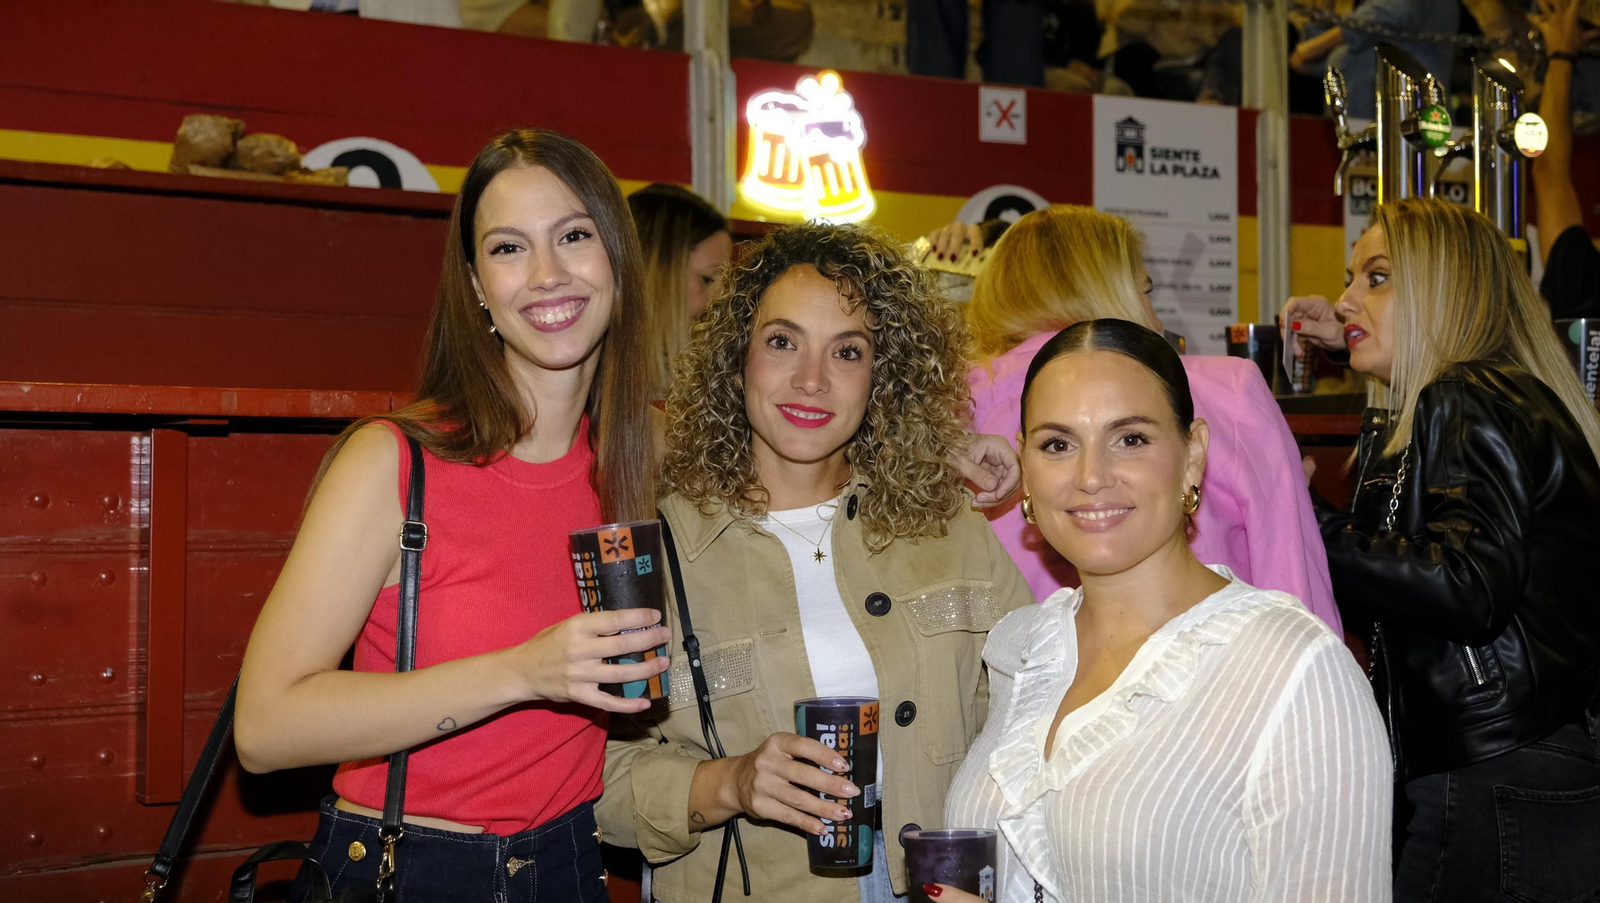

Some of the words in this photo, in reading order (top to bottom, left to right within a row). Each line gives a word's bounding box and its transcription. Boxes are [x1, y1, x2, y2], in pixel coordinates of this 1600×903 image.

[1150, 148, 1201, 162] SIENTE
[1150, 164, 1168, 176] LA
[1172, 165, 1220, 179] PLAZA
